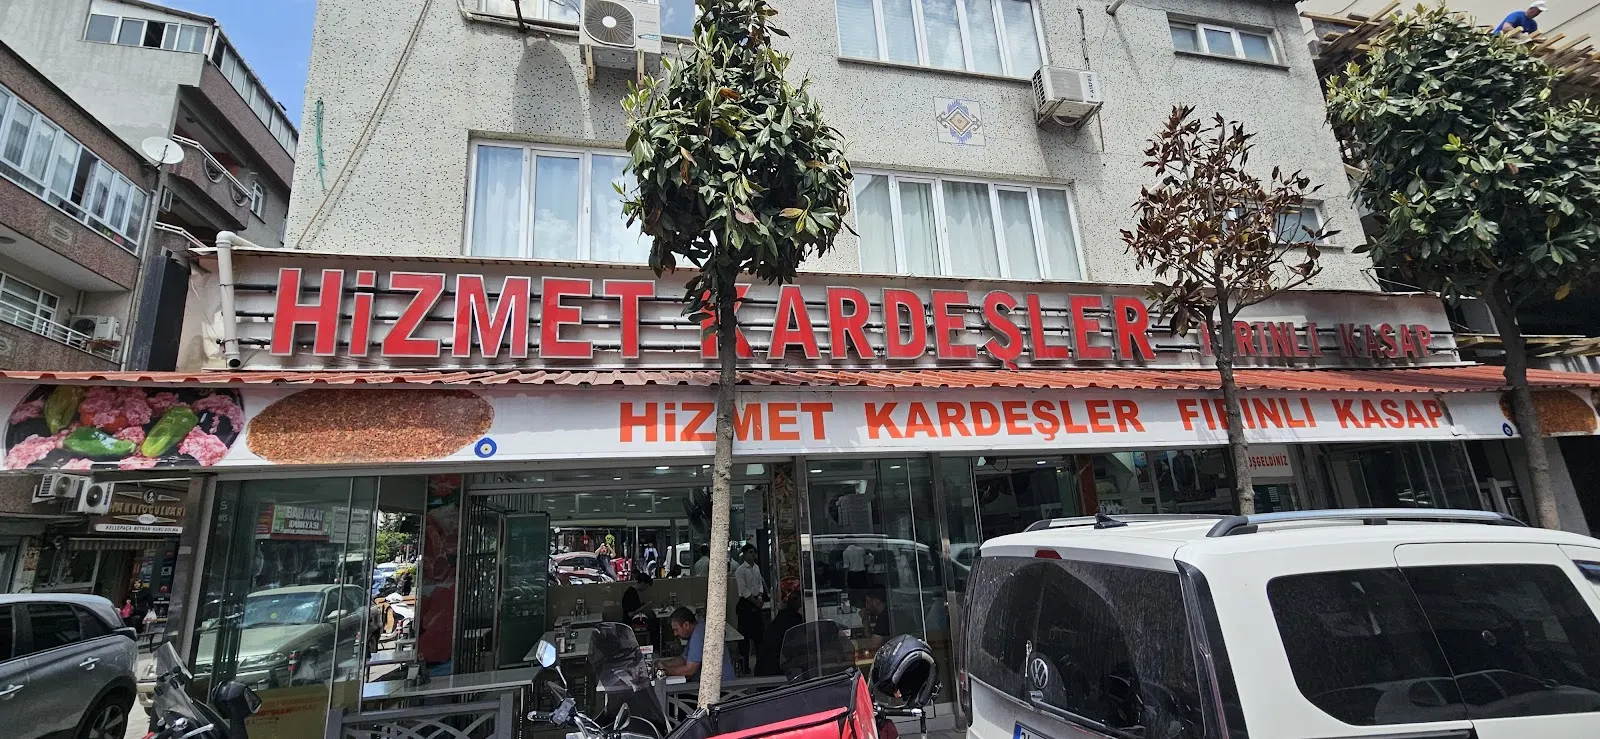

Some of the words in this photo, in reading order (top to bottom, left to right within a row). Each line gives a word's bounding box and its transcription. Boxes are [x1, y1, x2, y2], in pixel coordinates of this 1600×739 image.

[699, 282, 1156, 371] KARDEŞLER
[1200, 319, 1323, 358] RINLI
[1337, 322, 1432, 359] KASAP
[864, 399, 1147, 441] KARDEŞLER
[1330, 398, 1443, 429] KASAP
